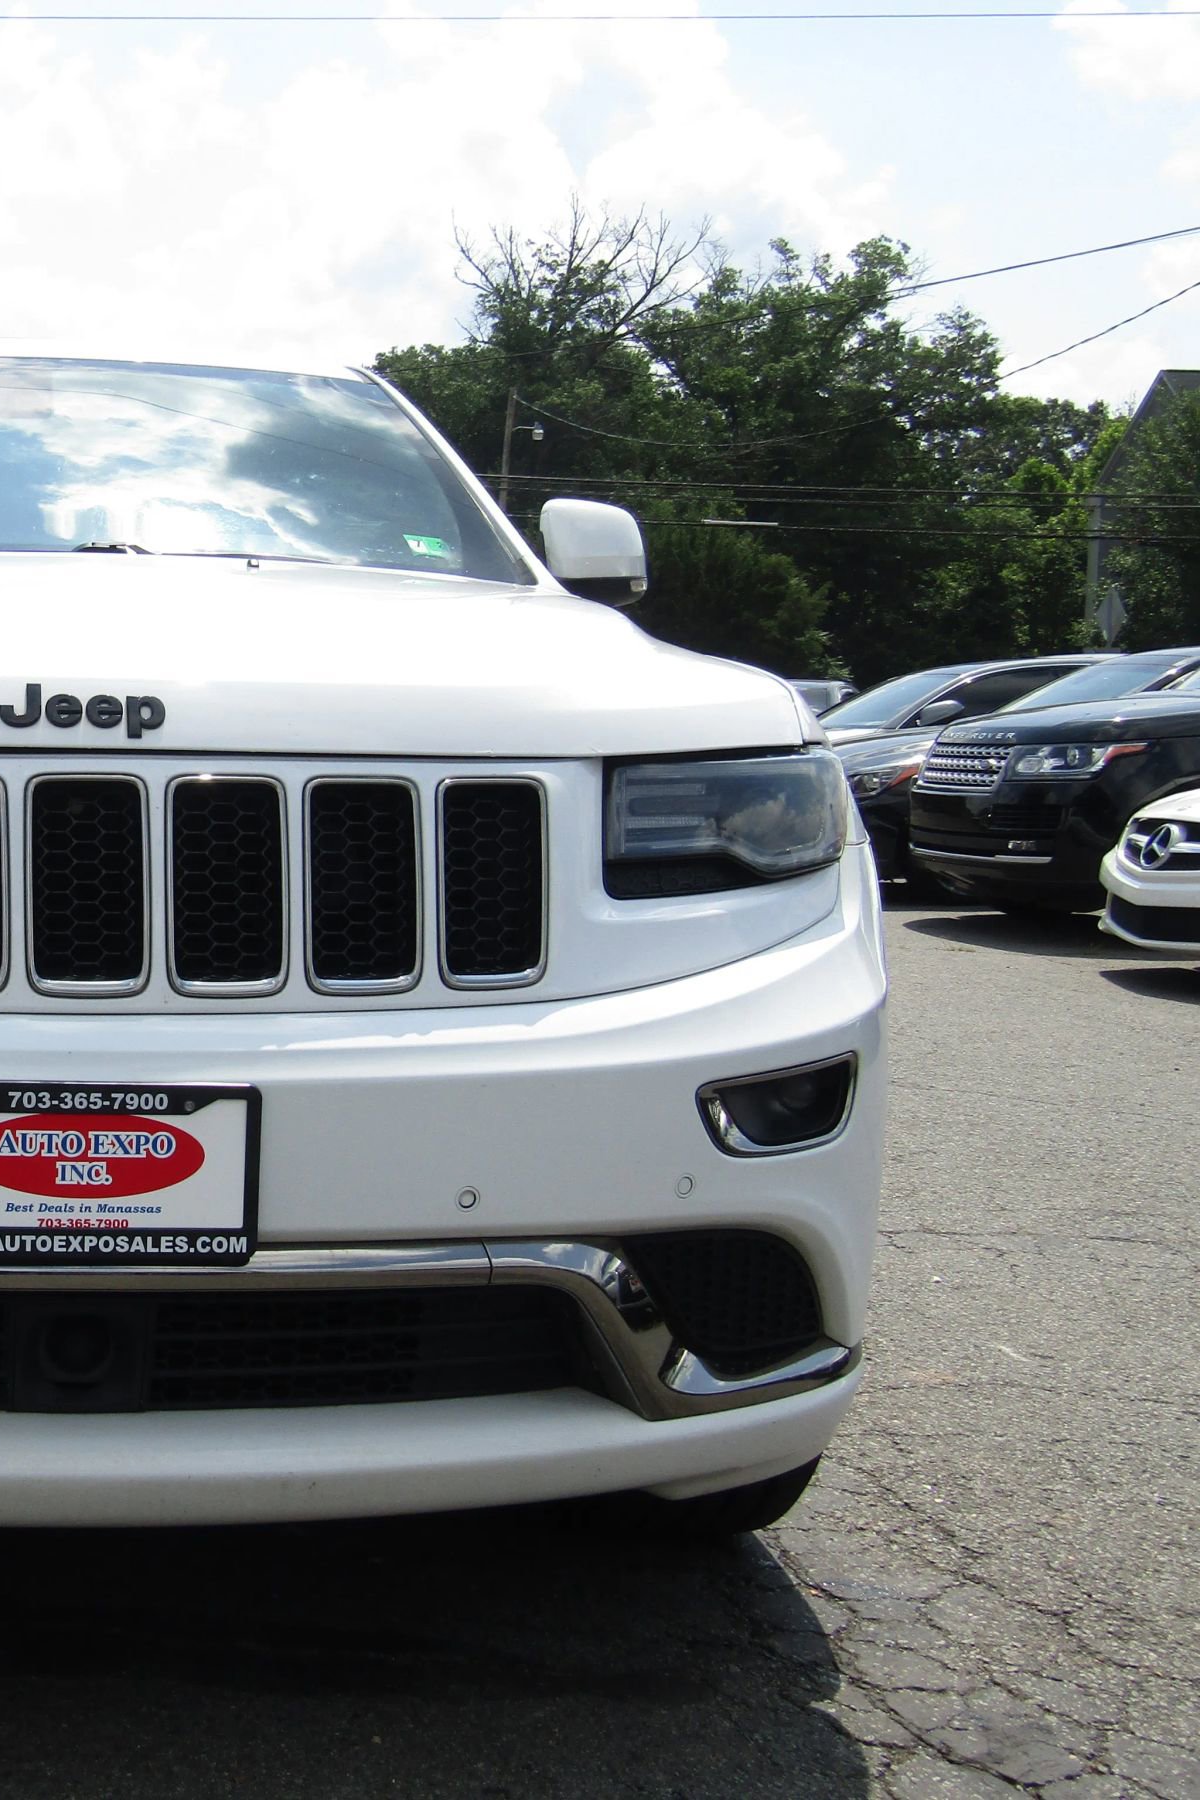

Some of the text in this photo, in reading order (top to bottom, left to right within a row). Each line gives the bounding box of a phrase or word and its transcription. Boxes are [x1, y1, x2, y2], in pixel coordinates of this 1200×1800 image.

[0, 683, 166, 739] Jeep
[8, 1091, 169, 1110] 703-365-7900
[88, 1131, 176, 1158] EXPO
[56, 1162, 112, 1185] INC.
[5, 1202, 162, 1214] Best Deals in Manassas
[37, 1218, 129, 1228] 703-365-7900
